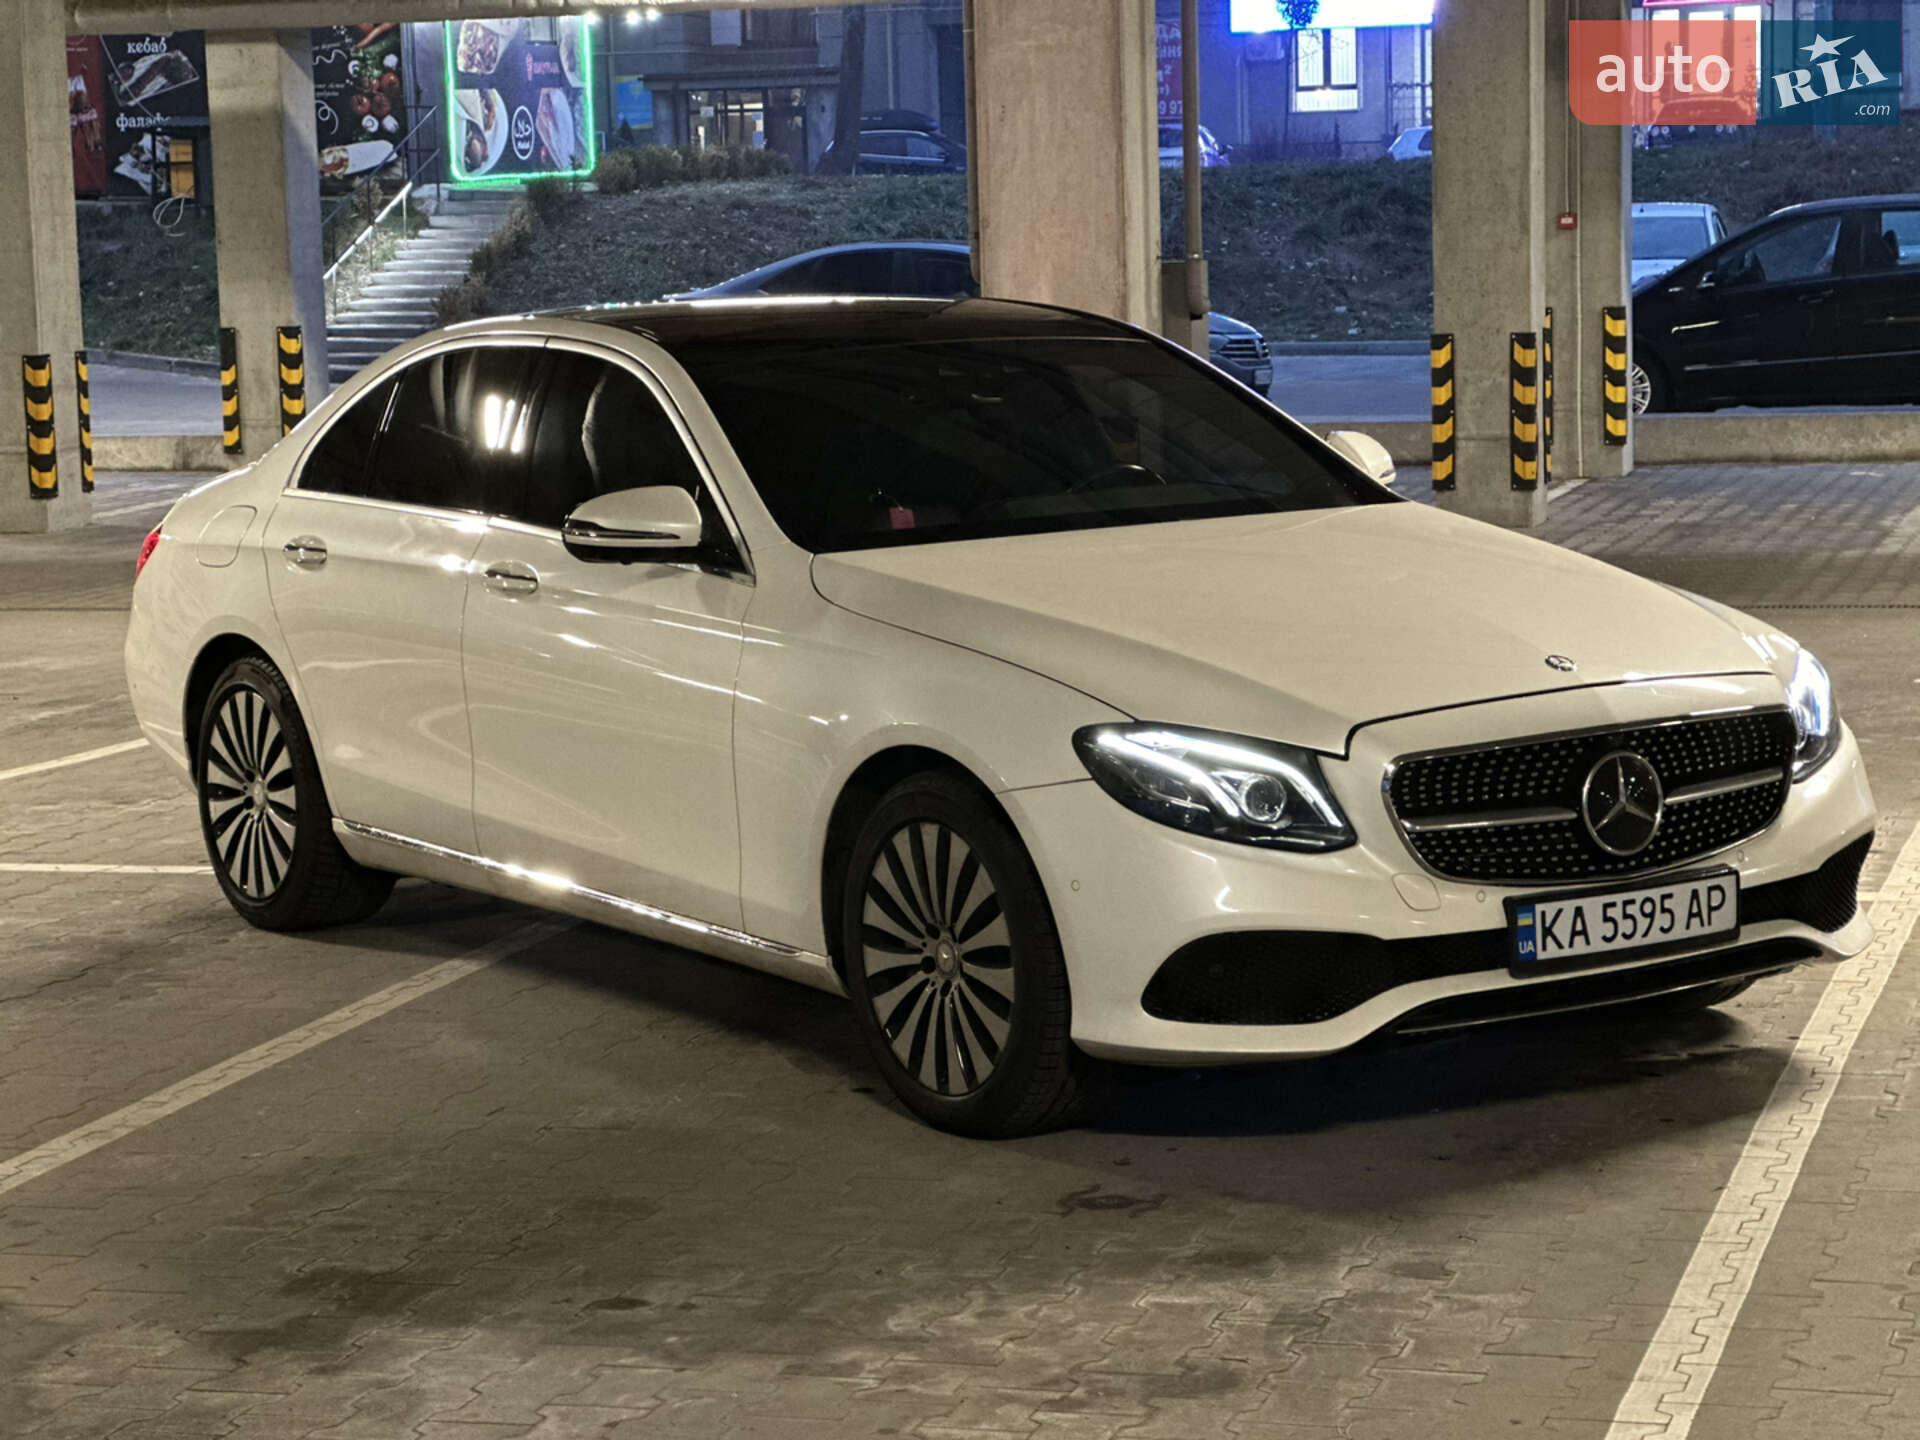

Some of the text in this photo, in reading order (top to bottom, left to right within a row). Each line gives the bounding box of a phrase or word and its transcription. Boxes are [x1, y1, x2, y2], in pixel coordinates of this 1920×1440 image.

[127, 36, 168, 54] кебаб
[115, 112, 171, 132] фалаф
[1541, 884, 1726, 952] KA 5595 AP
[1518, 941, 1535, 954] UA
